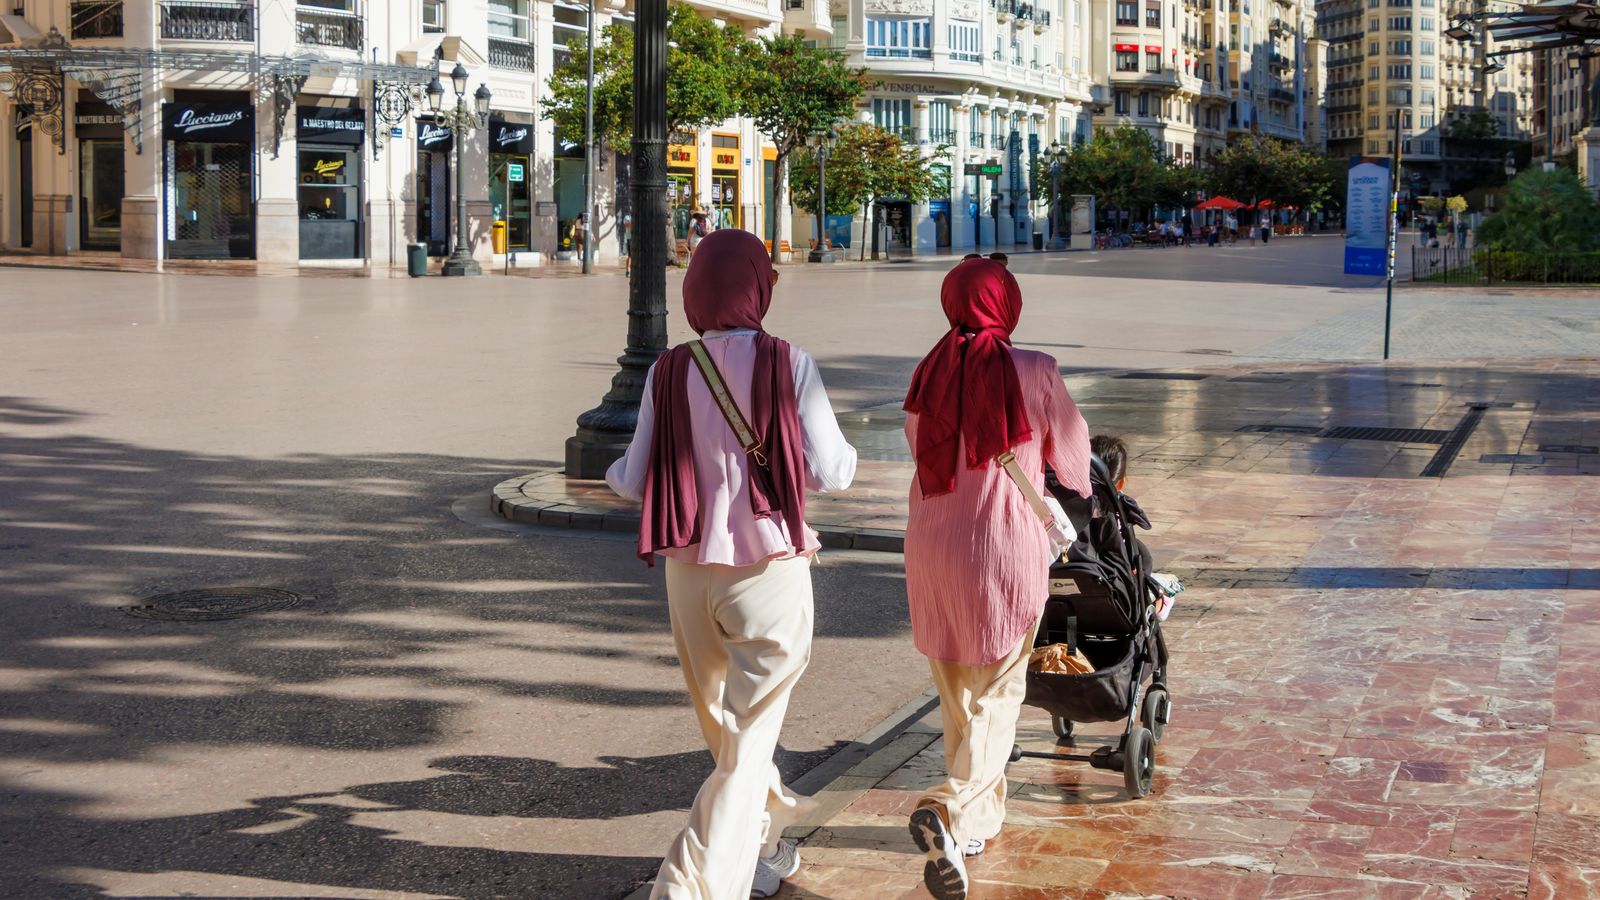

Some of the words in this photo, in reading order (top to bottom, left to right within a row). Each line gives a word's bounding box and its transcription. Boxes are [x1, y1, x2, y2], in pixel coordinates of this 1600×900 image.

[883, 82, 929, 94] VENECIA
[174, 109, 242, 133] Lucciano's
[309, 119, 334, 129] MAESTRO
[335, 120, 344, 129] DEL
[345, 121, 364, 130] GELATO
